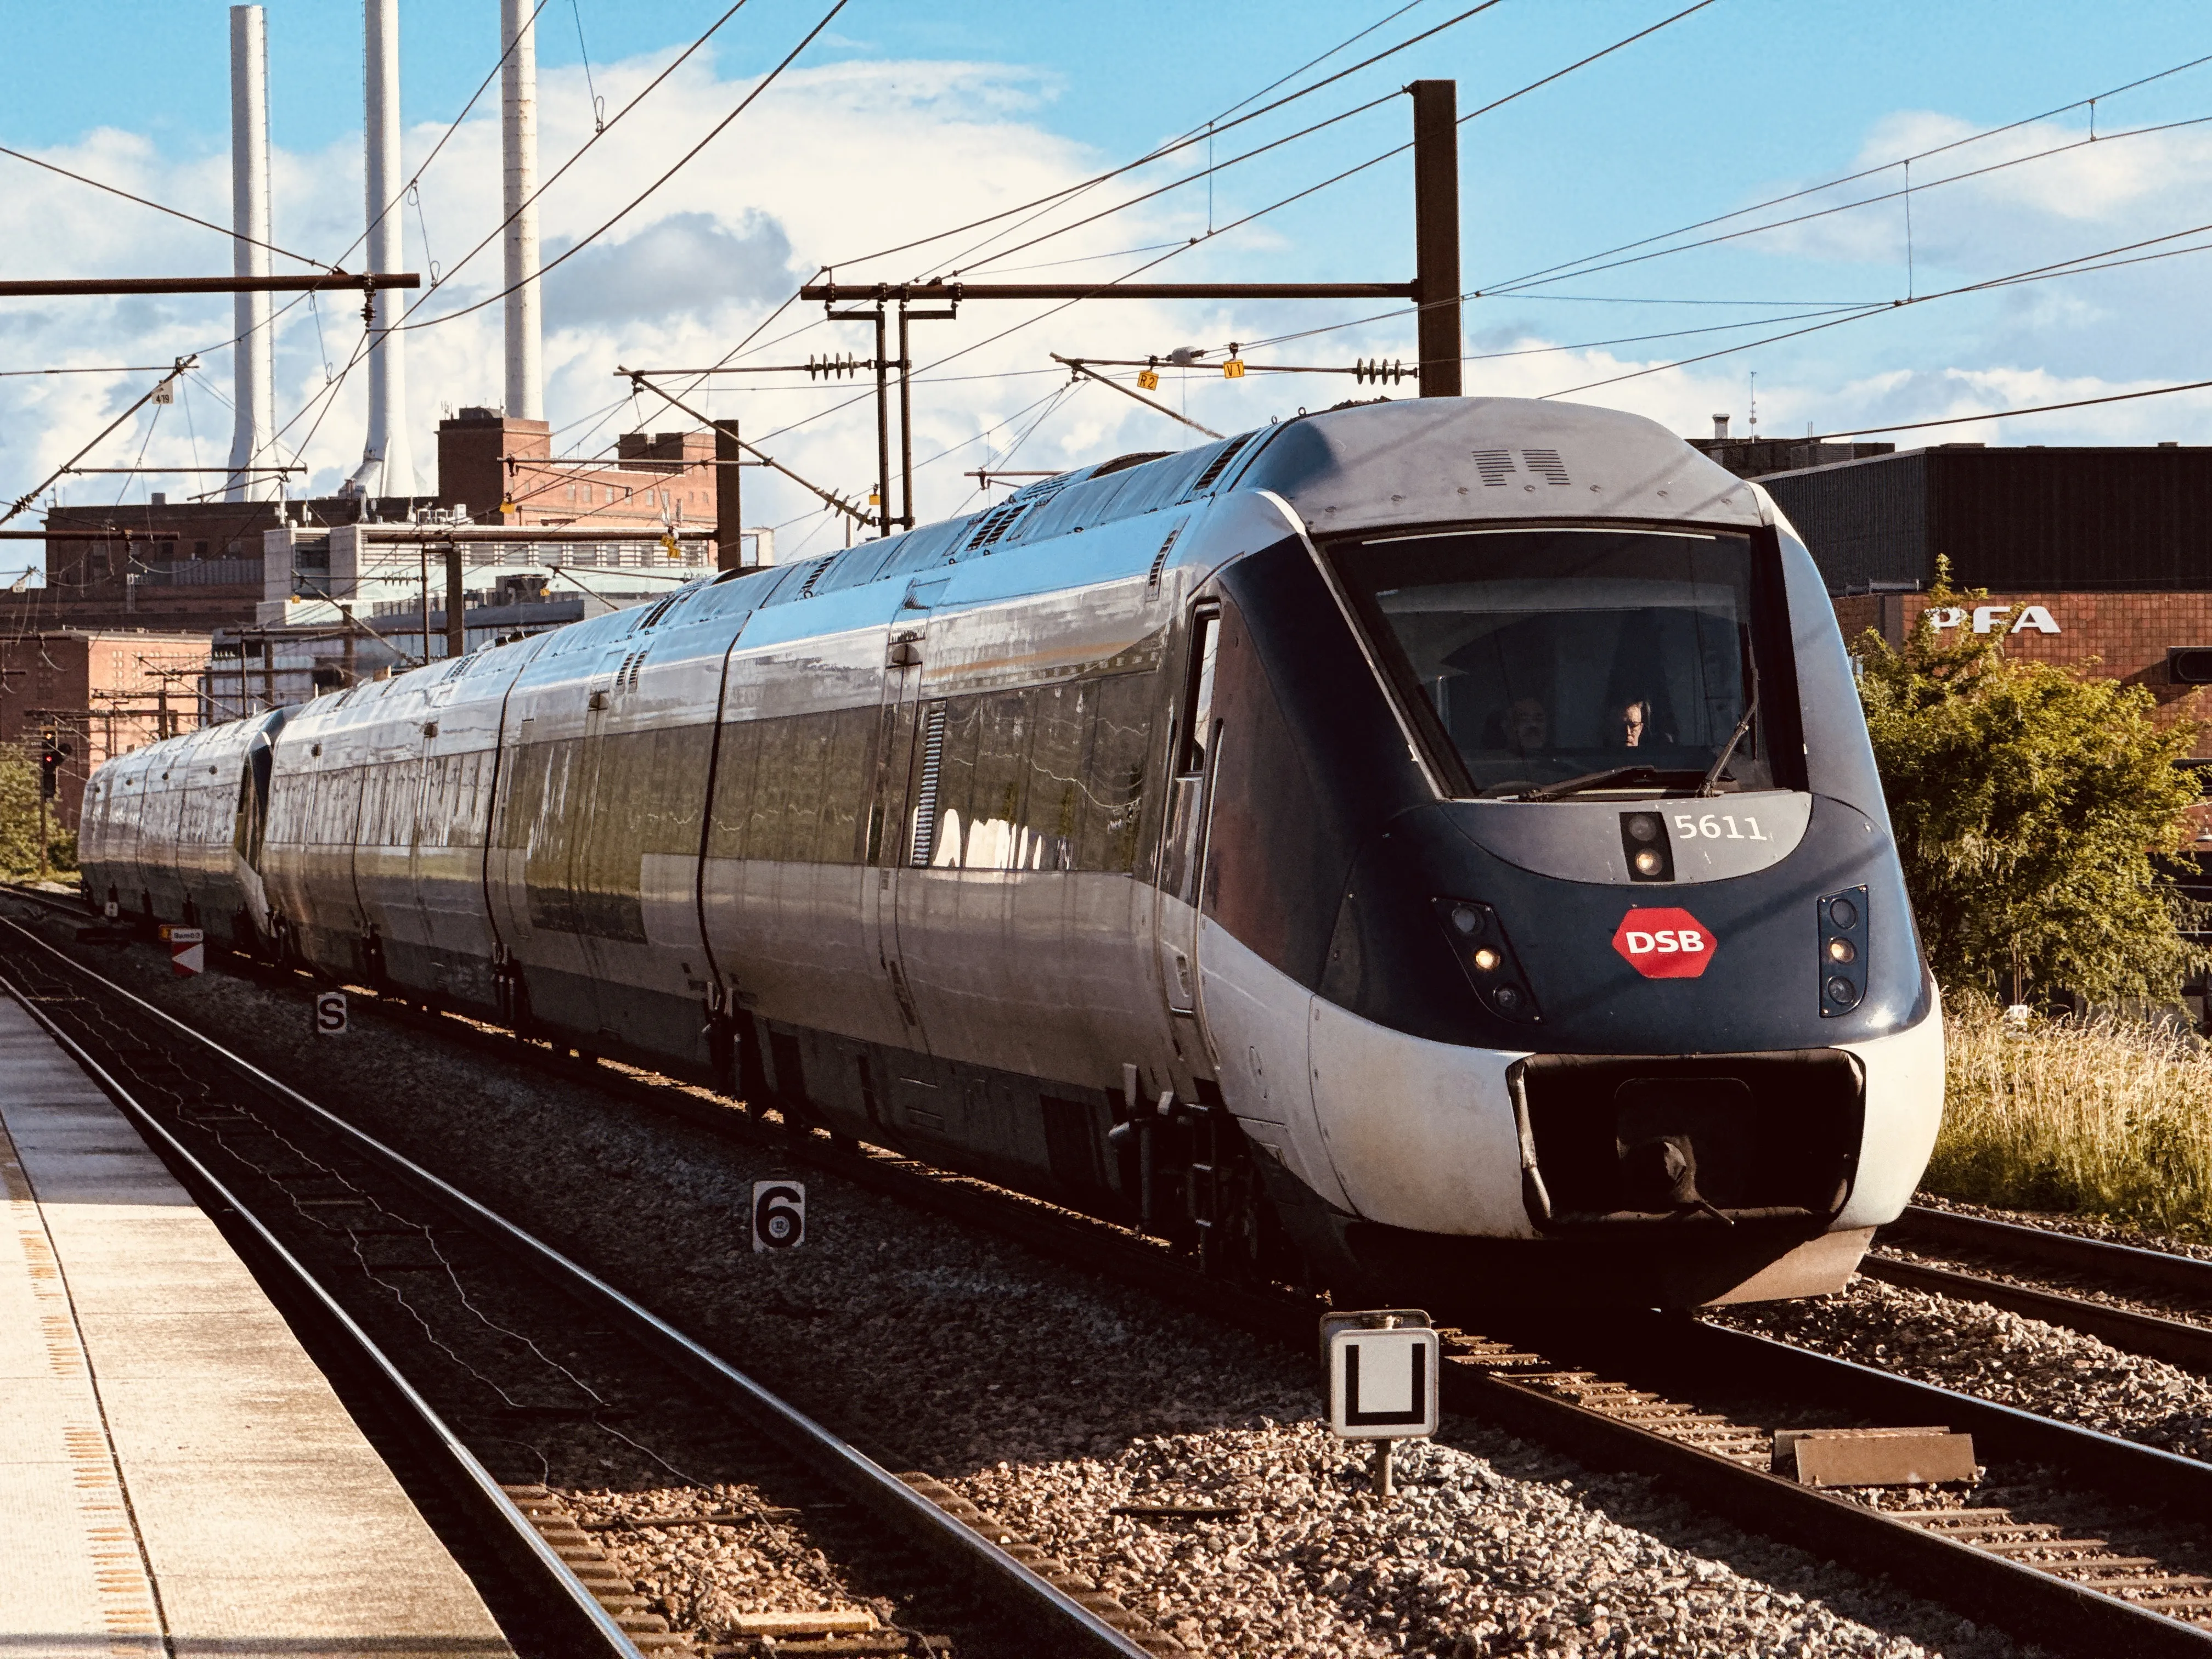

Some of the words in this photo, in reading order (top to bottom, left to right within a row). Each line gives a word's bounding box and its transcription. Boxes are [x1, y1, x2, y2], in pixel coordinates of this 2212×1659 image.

[1924, 606, 2061, 634] PFA
[1674, 814, 1767, 840] 5611
[1626, 930, 1705, 953] DSB
[319, 998, 345, 1030] S
[755, 1186, 802, 1248] 6
